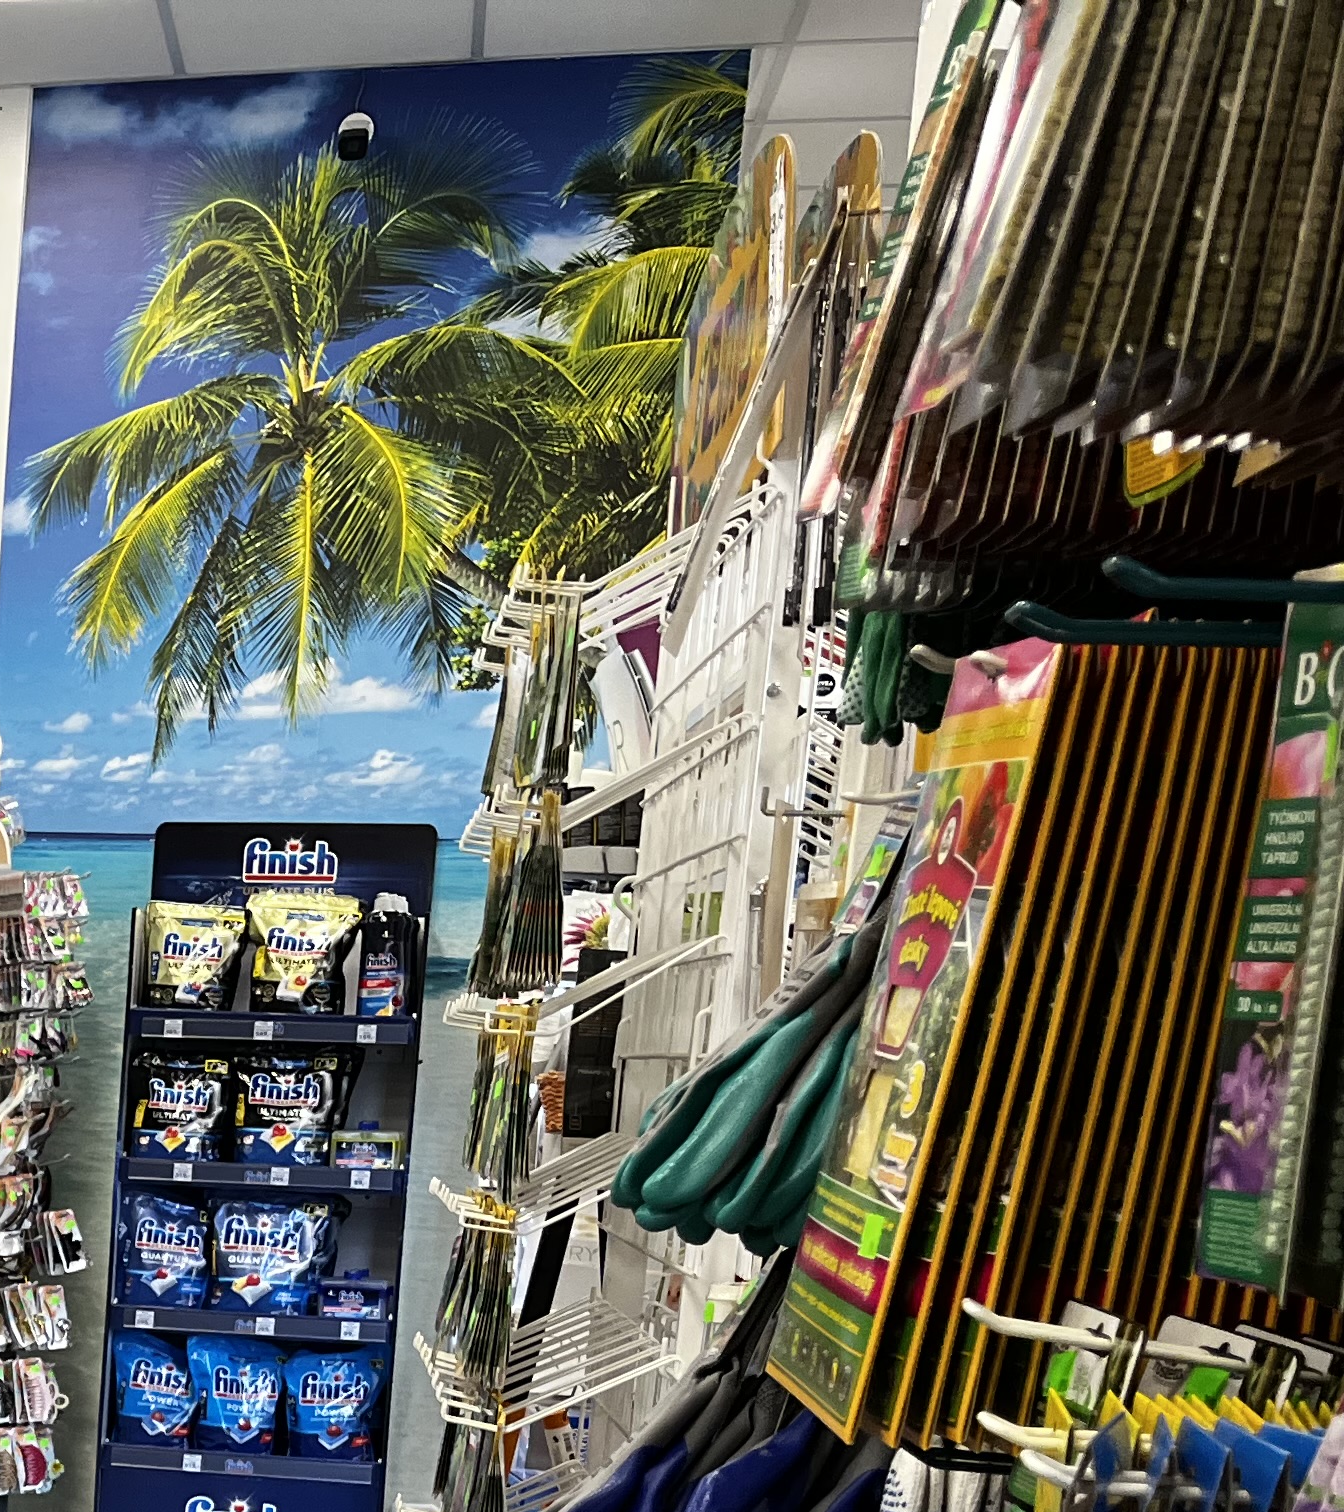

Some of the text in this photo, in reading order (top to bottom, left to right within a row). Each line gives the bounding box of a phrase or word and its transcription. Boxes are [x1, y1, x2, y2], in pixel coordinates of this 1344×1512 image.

[244, 839, 337, 884] finish
[135, 1218, 202, 1250] finish
[222, 1214, 300, 1252] finish
